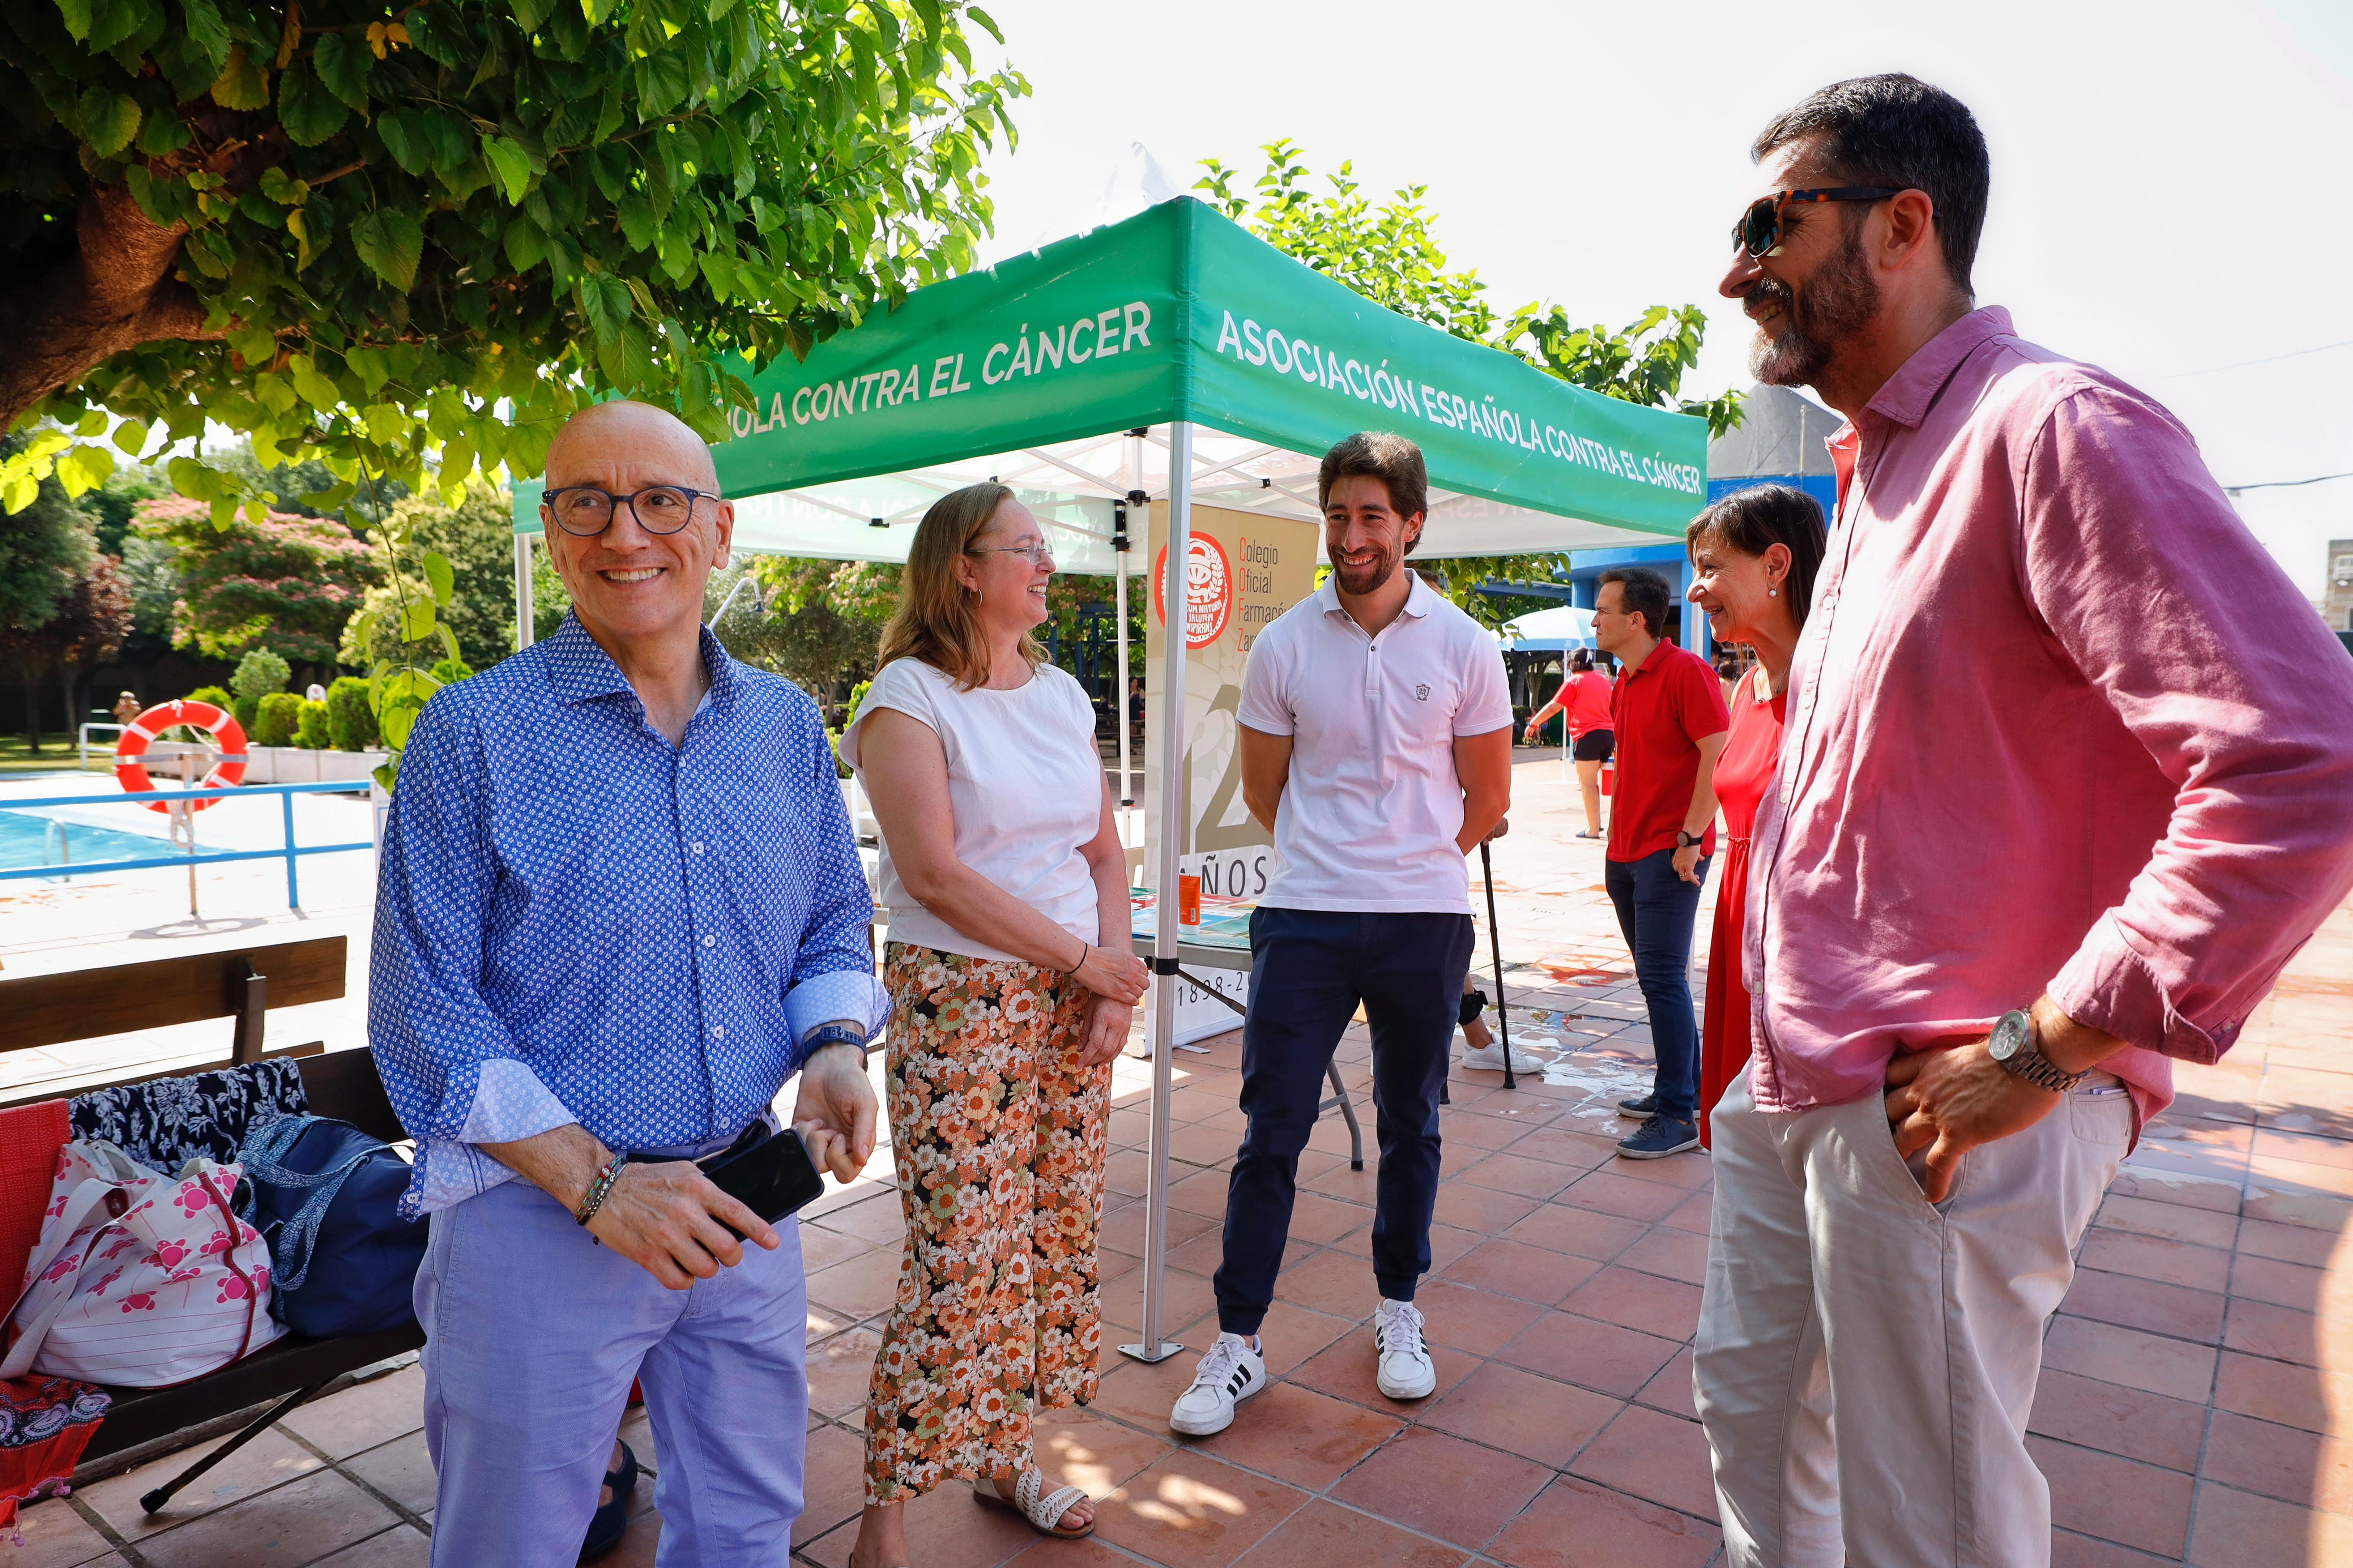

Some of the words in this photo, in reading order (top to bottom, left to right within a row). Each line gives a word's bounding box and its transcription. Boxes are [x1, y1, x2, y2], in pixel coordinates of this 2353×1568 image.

[715, 392, 787, 445] OLA
[792, 364, 920, 425] CONTRA
[929, 353, 971, 398] EL
[982, 301, 1151, 385] CÁNCER
[1216, 310, 1420, 417] ASOCIACIÓN
[1421, 385, 1546, 453] ESPAÑOLA
[1546, 425, 1624, 477] CONTRA
[1620, 450, 1645, 482] EL
[1643, 452, 1701, 495] CÁNCER
[1239, 537, 1278, 568] Colegio
[1239, 568, 1272, 594] Oficial
[1189, 613, 1213, 623] SALUTEM
[1199, 599, 1222, 614] NATURA
[1180, 854, 1266, 897] ÑOS
